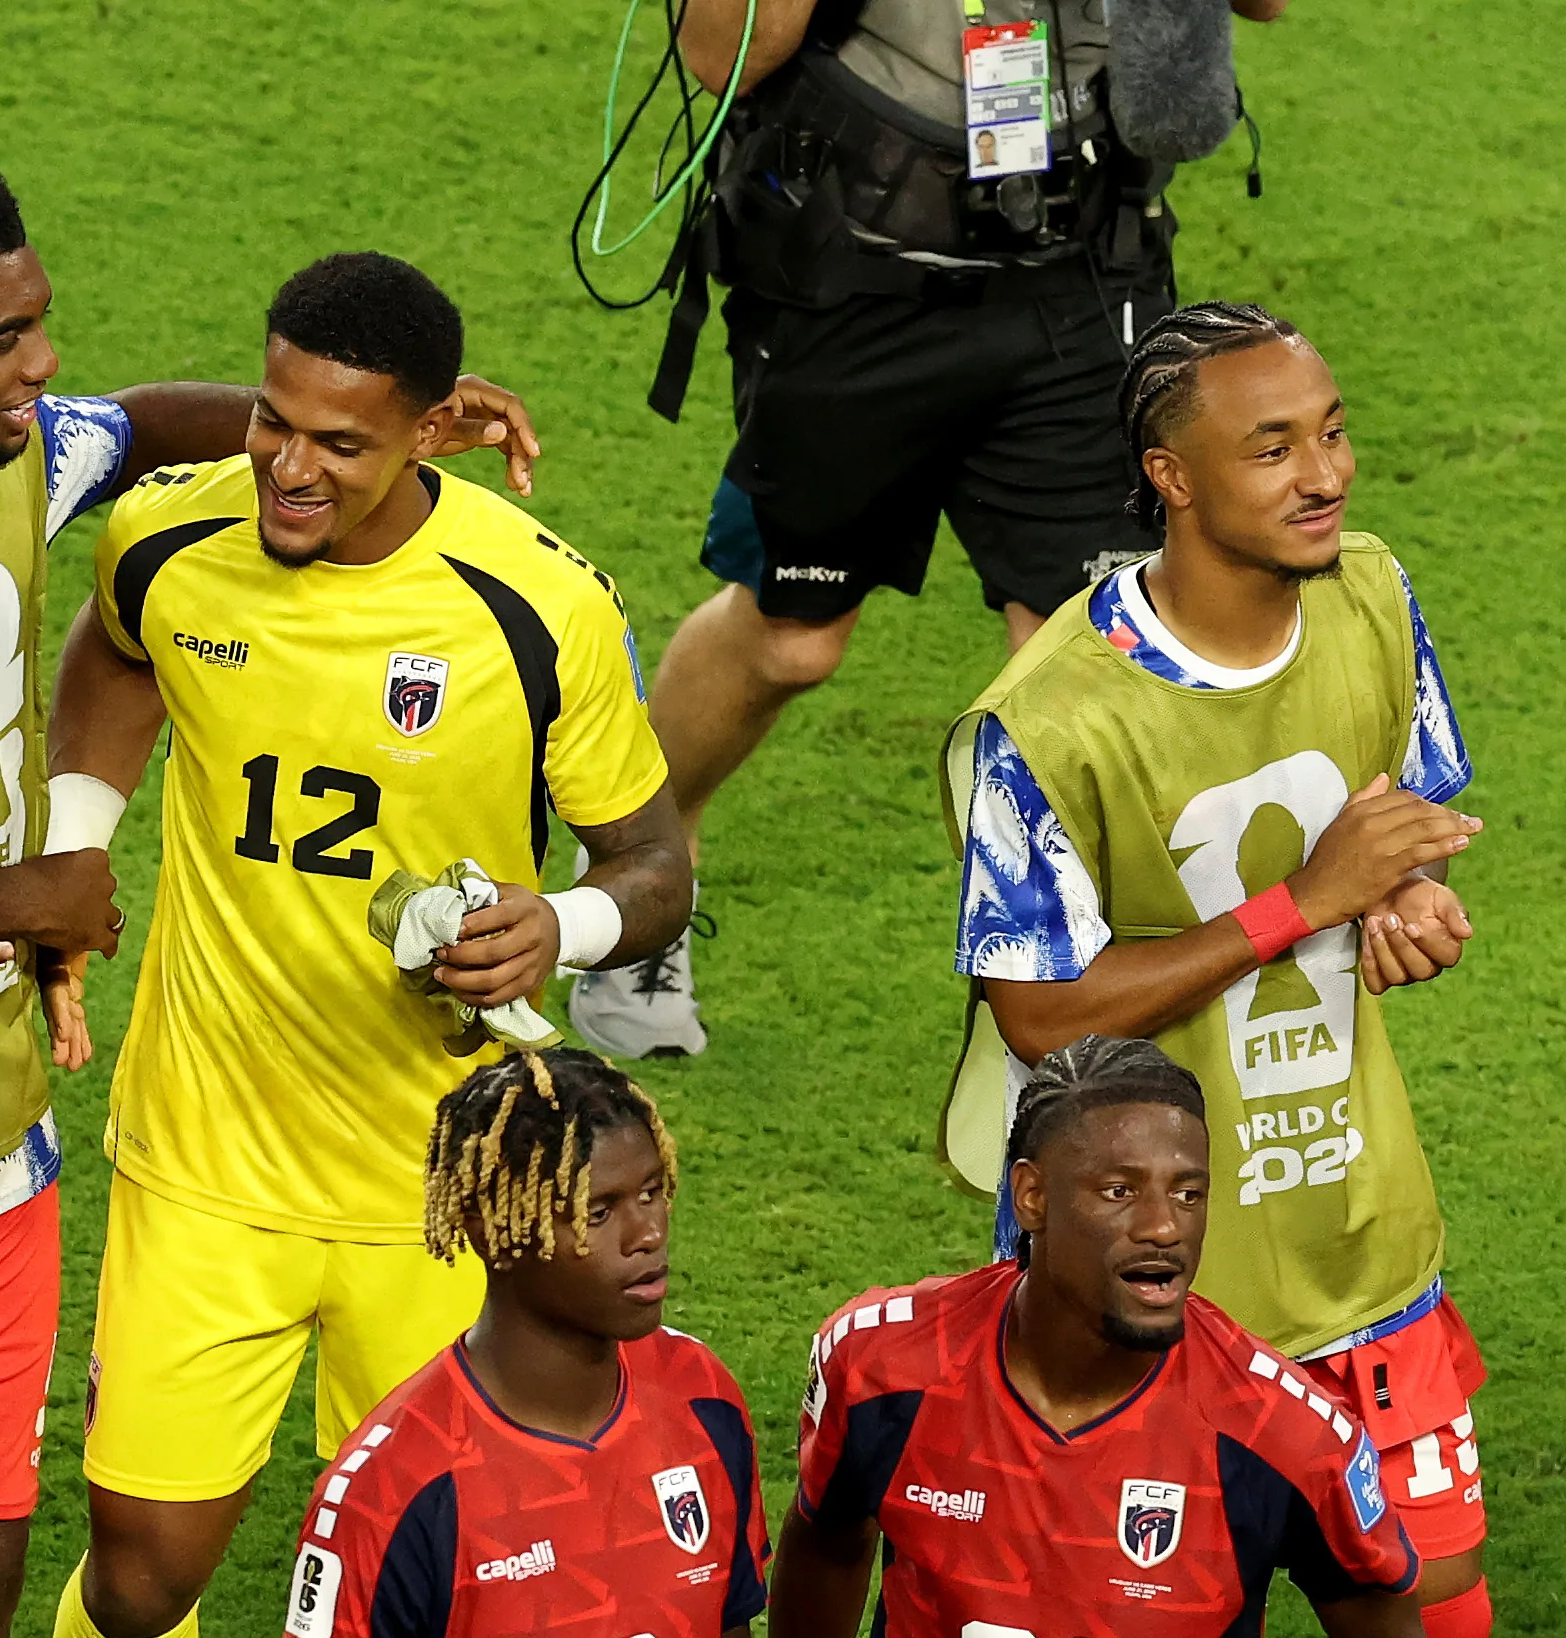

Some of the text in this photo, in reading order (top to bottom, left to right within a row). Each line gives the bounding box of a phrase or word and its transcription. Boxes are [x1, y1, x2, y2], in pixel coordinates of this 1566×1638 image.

[173, 632, 250, 666] capelli
[205, 655, 245, 672] SPORT
[393, 657, 444, 674] FCF
[235, 753, 382, 880] 12
[1244, 1022, 1338, 1070] FIFA
[658, 1471, 691, 1490] FCF
[905, 1484, 987, 1516] capelli
[1128, 1483, 1179, 1500] FCF
[937, 1507, 983, 1523] SPORT
[476, 1539, 556, 1581] capelli
[514, 1562, 557, 1581] SPORT
